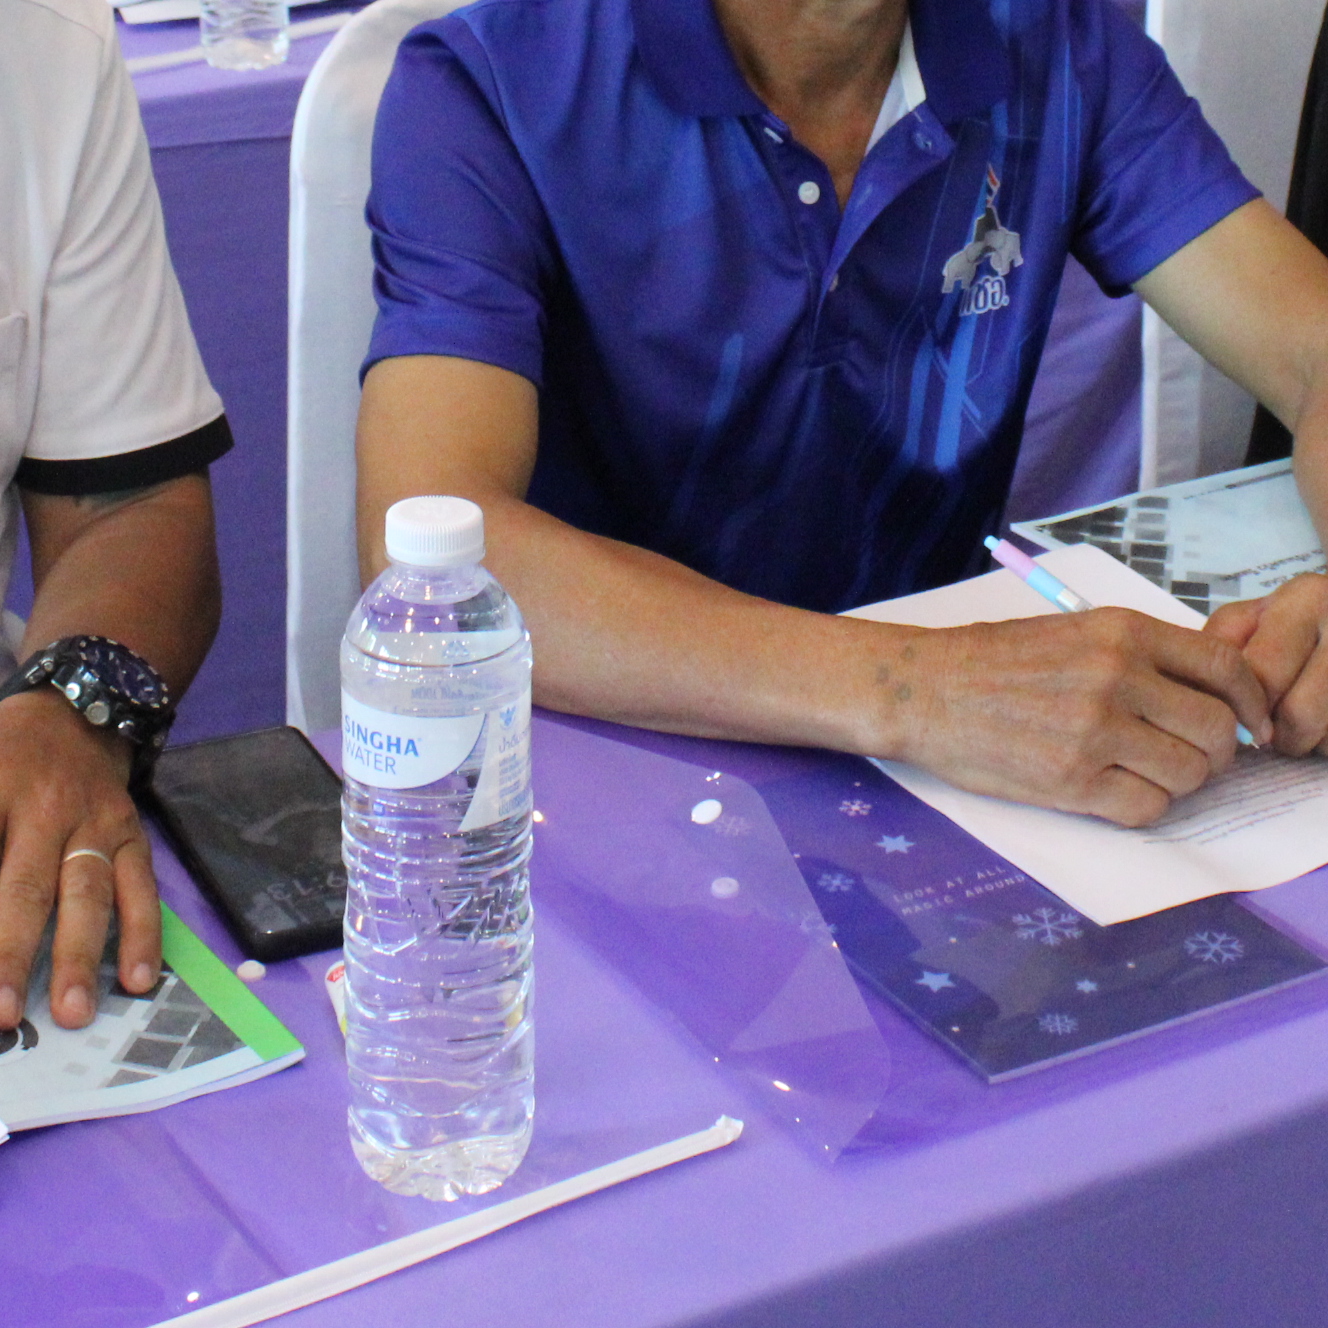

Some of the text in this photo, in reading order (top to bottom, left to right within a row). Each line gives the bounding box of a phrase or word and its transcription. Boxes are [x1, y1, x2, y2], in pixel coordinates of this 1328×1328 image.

[344, 714, 419, 757] SINGHA
[344, 736, 396, 775] WATER
[893, 865, 1006, 903] LOOK AT ALL
[901, 874, 1025, 916] MAGIC AROUND
